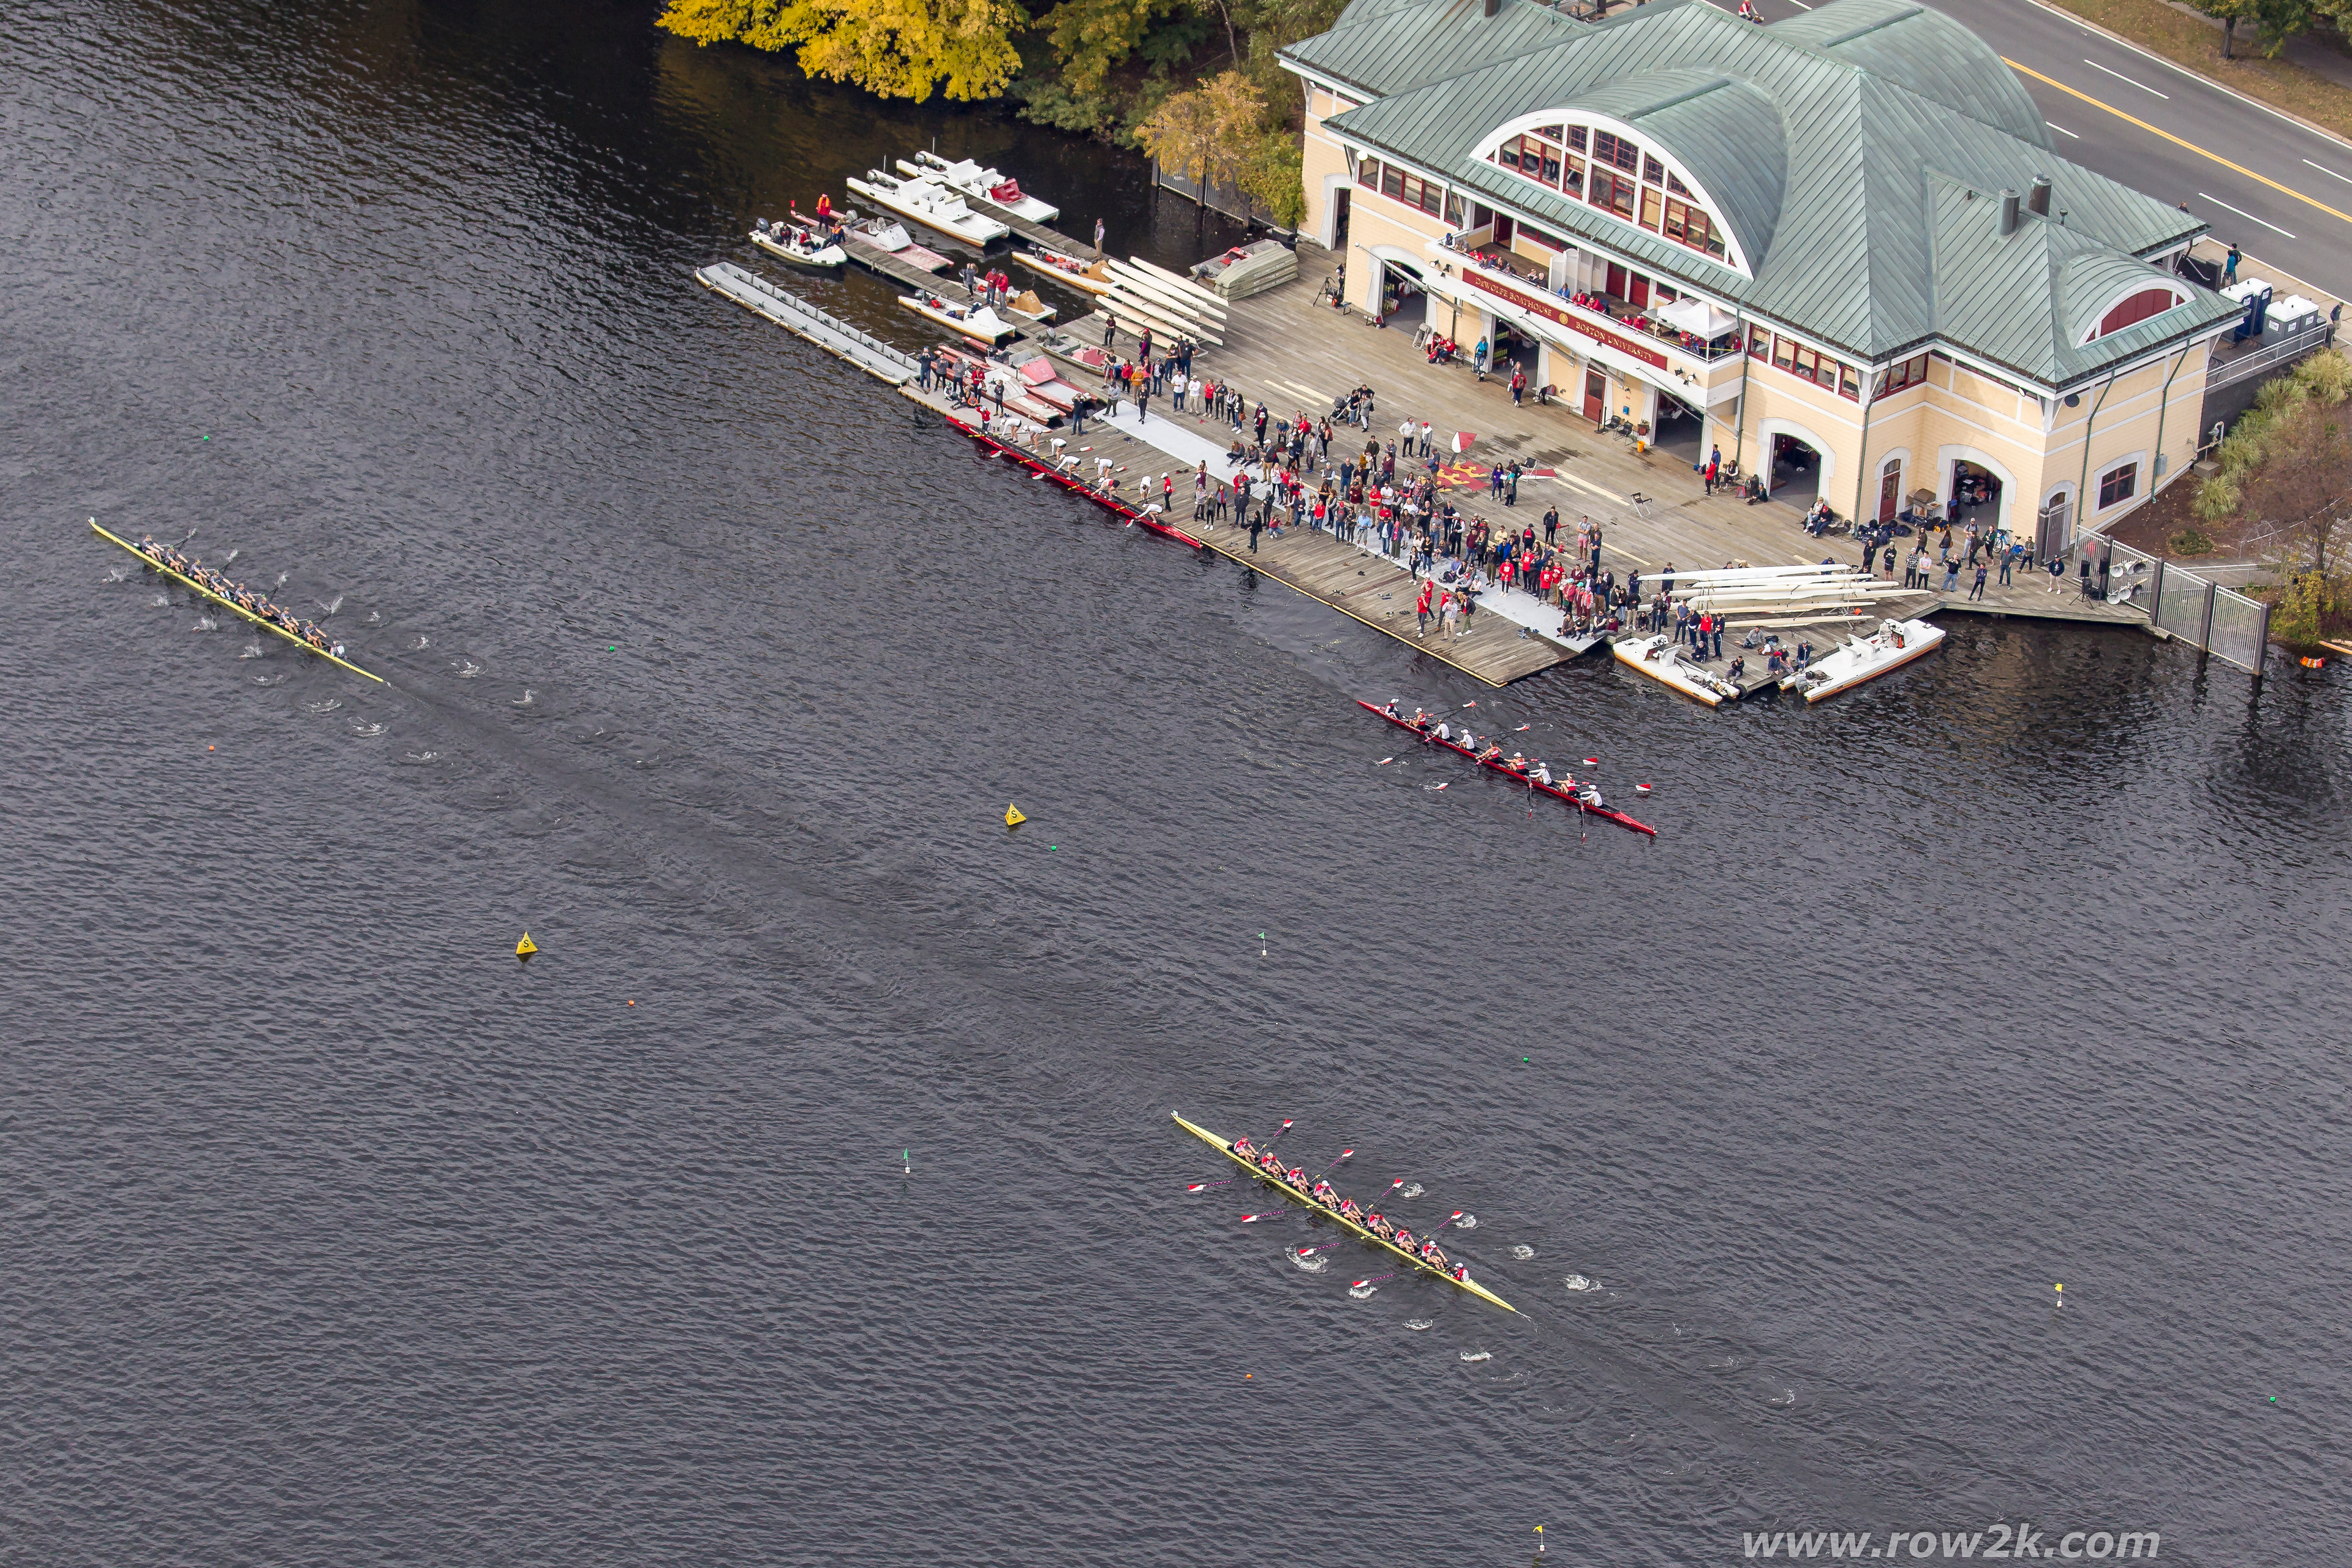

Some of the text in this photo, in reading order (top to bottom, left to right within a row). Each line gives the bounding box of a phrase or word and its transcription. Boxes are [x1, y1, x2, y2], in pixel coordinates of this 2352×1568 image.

[1509, 292, 1552, 317] BOATHOUSE
[1575, 322, 1605, 341] BOSTON
[1608, 336, 1654, 361] UNIVERSITY
